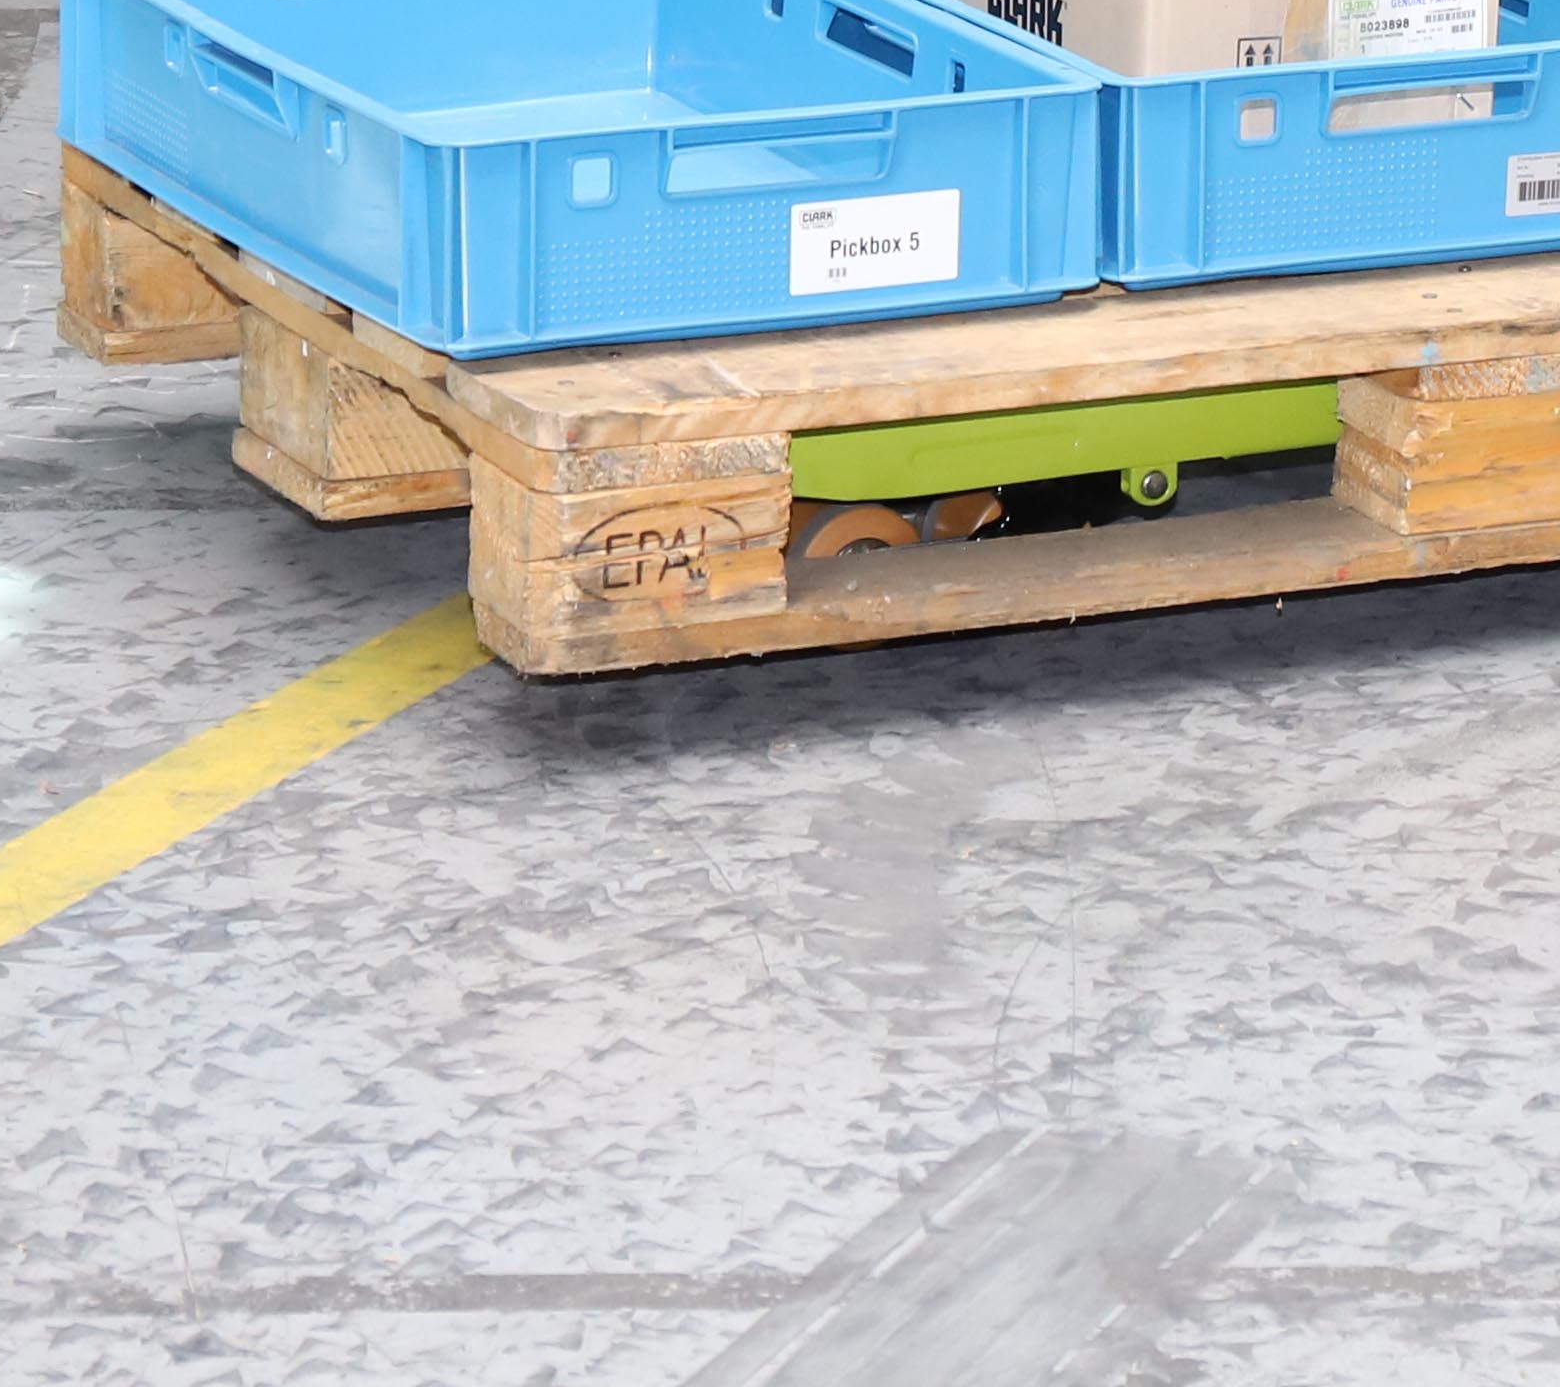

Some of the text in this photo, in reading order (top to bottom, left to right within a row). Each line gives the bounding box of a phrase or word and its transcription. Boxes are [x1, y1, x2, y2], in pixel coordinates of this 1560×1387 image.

[1360, 18, 1410, 33] 8023898
[802, 210, 833, 223] CLARK
[830, 232, 920, 259] Pickbox 5
